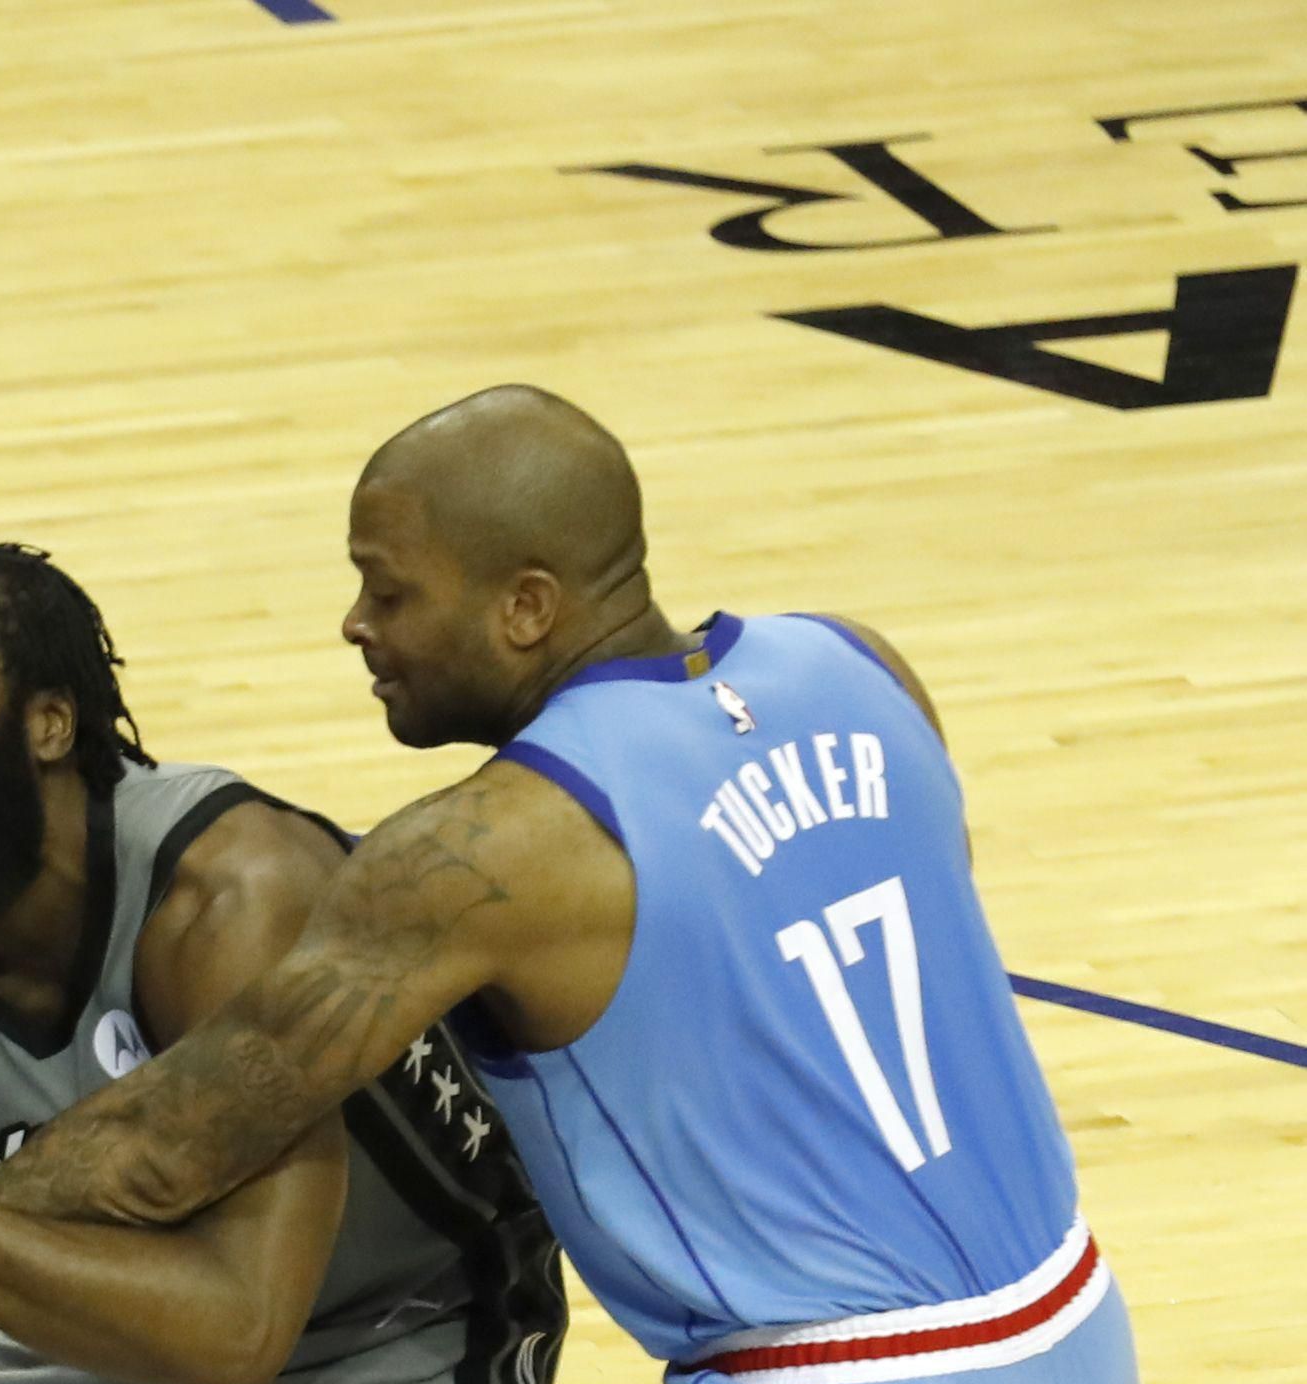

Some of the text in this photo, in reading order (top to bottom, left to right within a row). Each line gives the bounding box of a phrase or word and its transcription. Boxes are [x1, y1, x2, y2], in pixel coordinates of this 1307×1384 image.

[763, 263, 1299, 411] A
[699, 732, 889, 877] TUCKER
[774, 875, 952, 1173] 17
